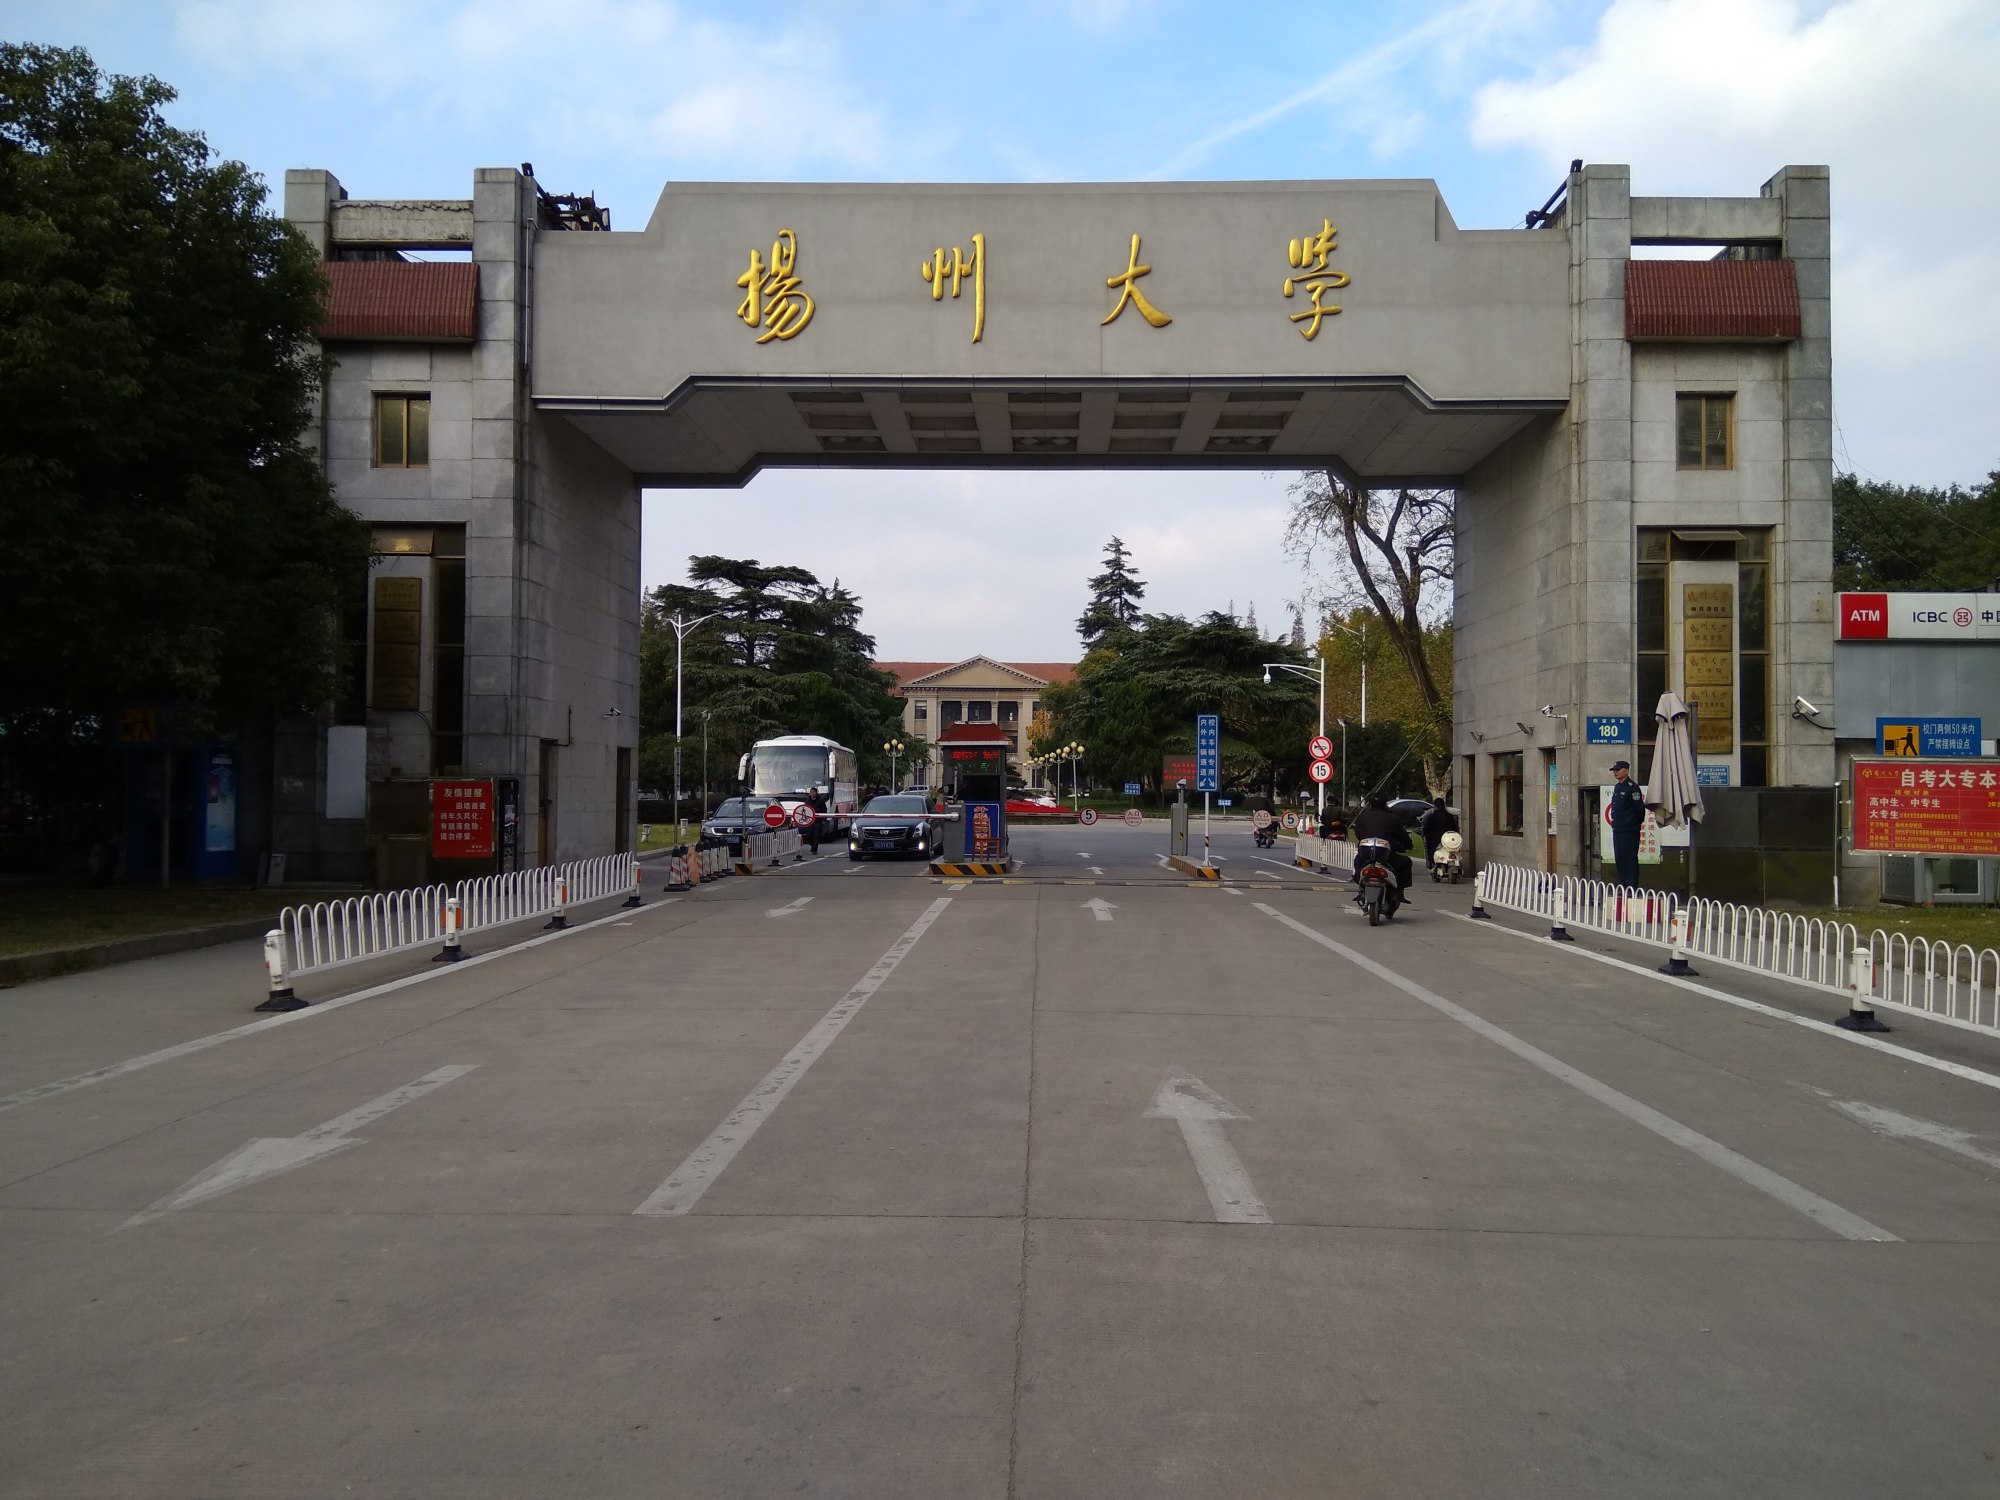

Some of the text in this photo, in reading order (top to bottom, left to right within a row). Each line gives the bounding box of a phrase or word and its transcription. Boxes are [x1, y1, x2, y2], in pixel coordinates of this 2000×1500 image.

[1850, 610, 1880, 621] ATM
[1913, 612, 1947, 622] ICBC
[1982, 610, 2000, 622] 中
[1599, 725, 1618, 737] 180
[1923, 723, 1975, 735] 校门两侧50米内
[1316, 765, 1326, 776] 15
[1901, 769, 2000, 789] 自考大专本
[444, 788, 482, 798] 友情提醒
[1085, 810, 1092, 820] 5
[1287, 813, 1294, 824] 5
